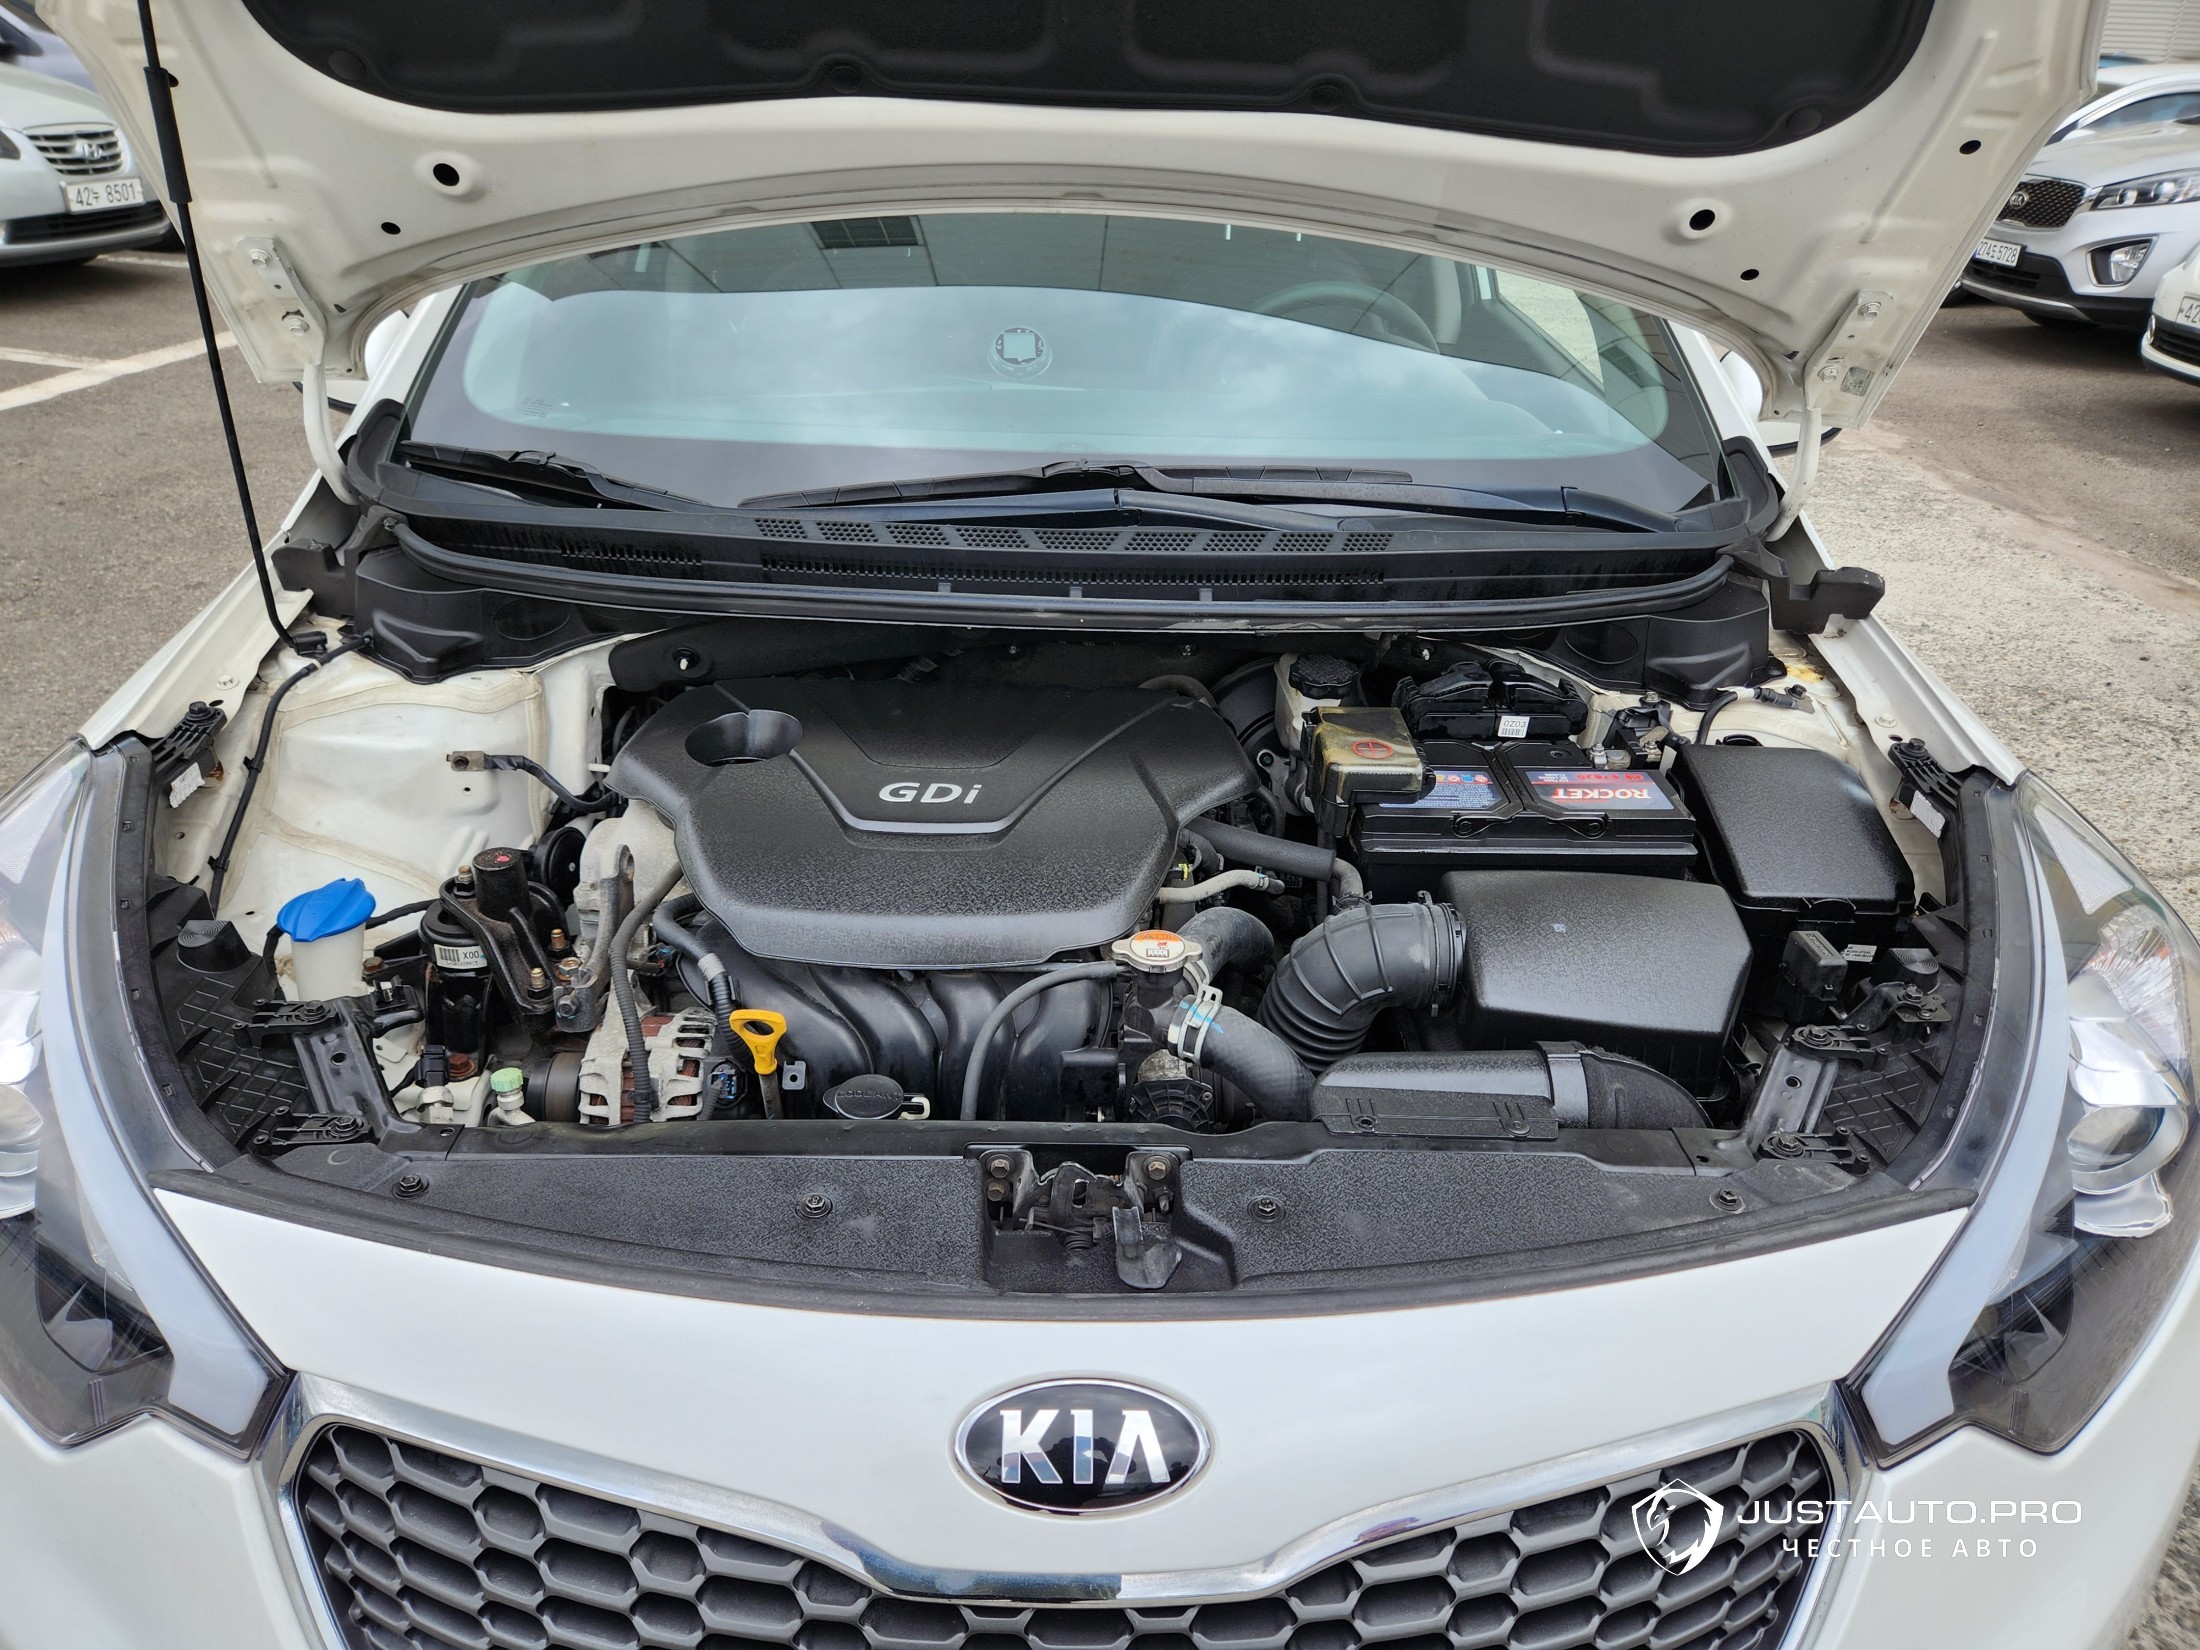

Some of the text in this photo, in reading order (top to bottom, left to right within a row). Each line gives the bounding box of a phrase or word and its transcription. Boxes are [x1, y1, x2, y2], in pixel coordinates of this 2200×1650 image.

[106, 183, 136, 203] 8501
[1997, 245, 2018, 263] 5728
[879, 782, 982, 804] GDi
[1552, 787, 1652, 800] ROCKET
[1000, 1409, 1171, 1484] KIA
